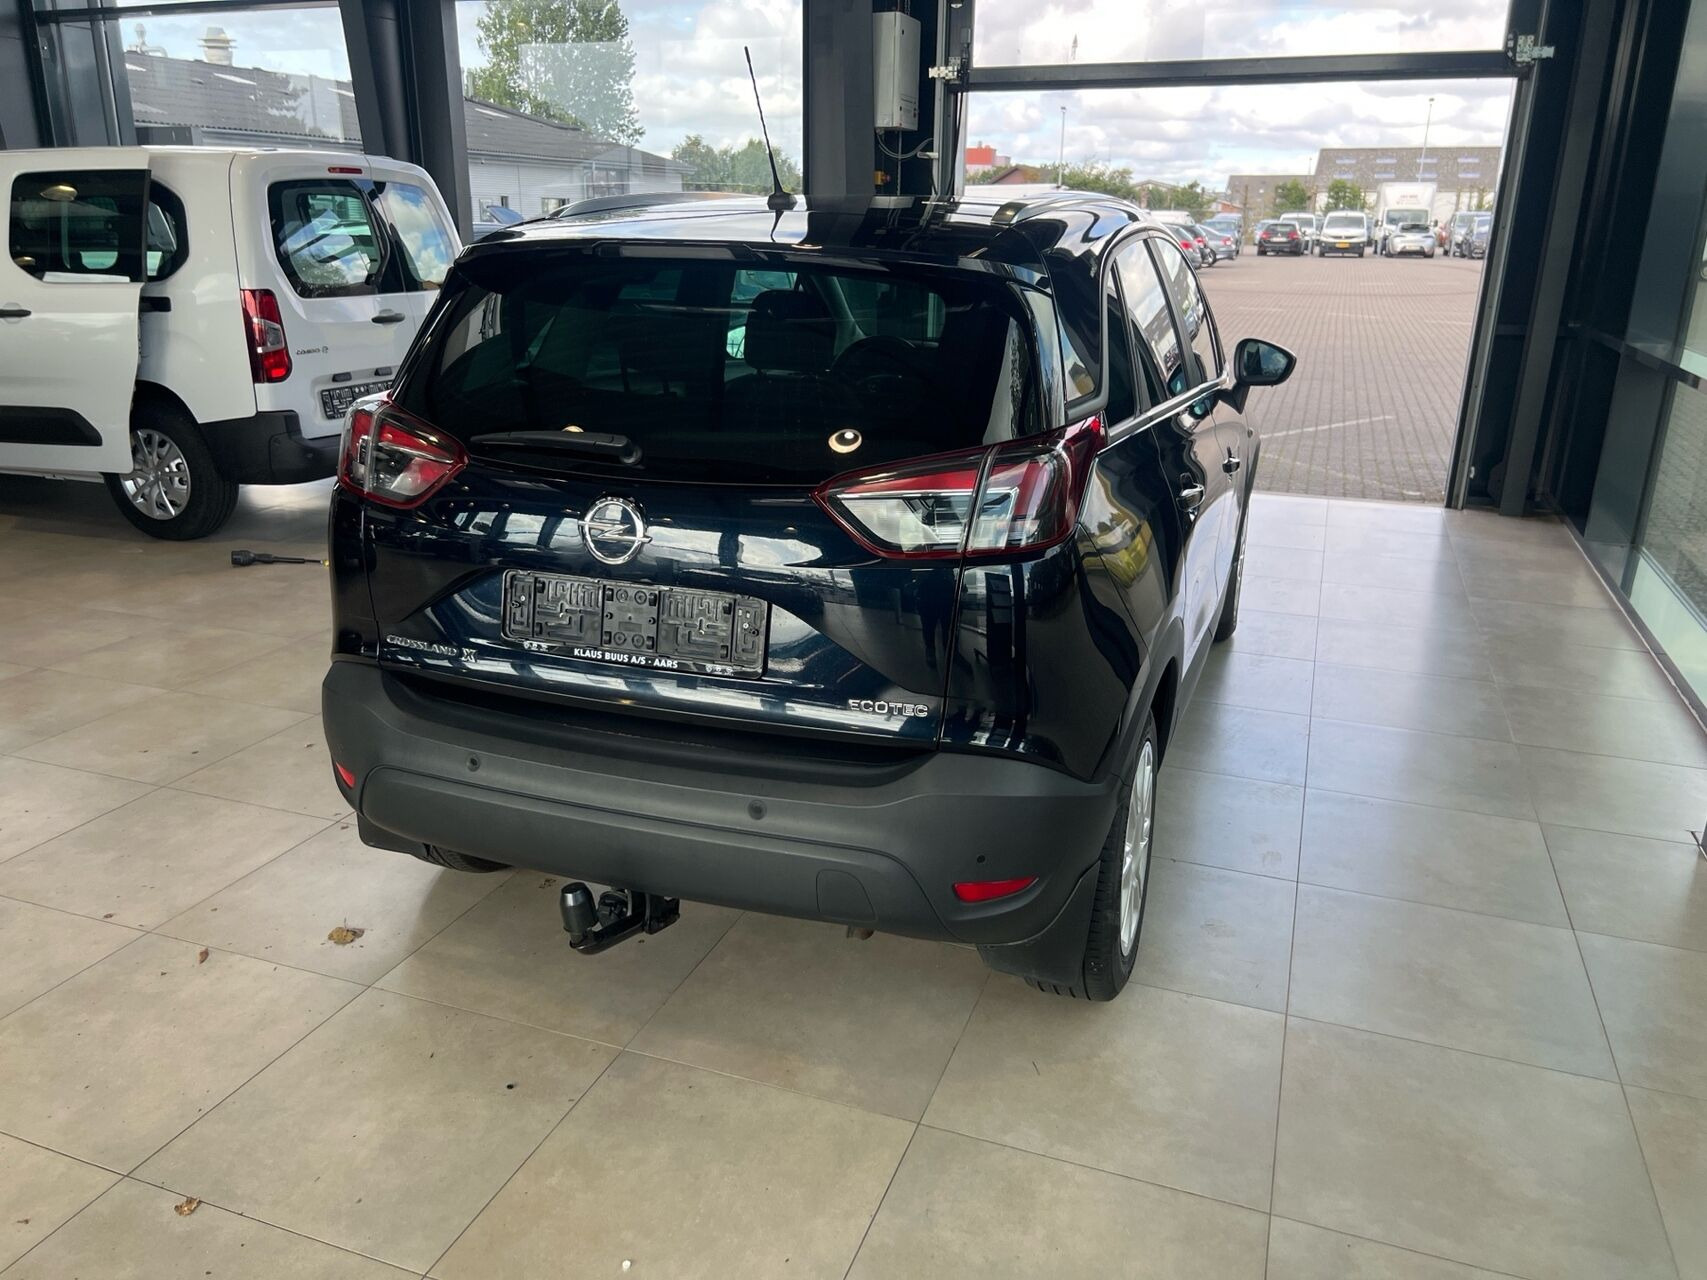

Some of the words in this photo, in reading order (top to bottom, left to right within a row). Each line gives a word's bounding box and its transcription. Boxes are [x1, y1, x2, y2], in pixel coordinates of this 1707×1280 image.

[386, 634, 457, 656] CROSSLAND
[462, 647, 477, 663] X
[573, 648, 602, 659] KLAUS
[604, 652, 629, 663] BUUS
[630, 656, 646, 665] A/S
[653, 658, 678, 669] AARS
[847, 699, 928, 717] ECOTEC
